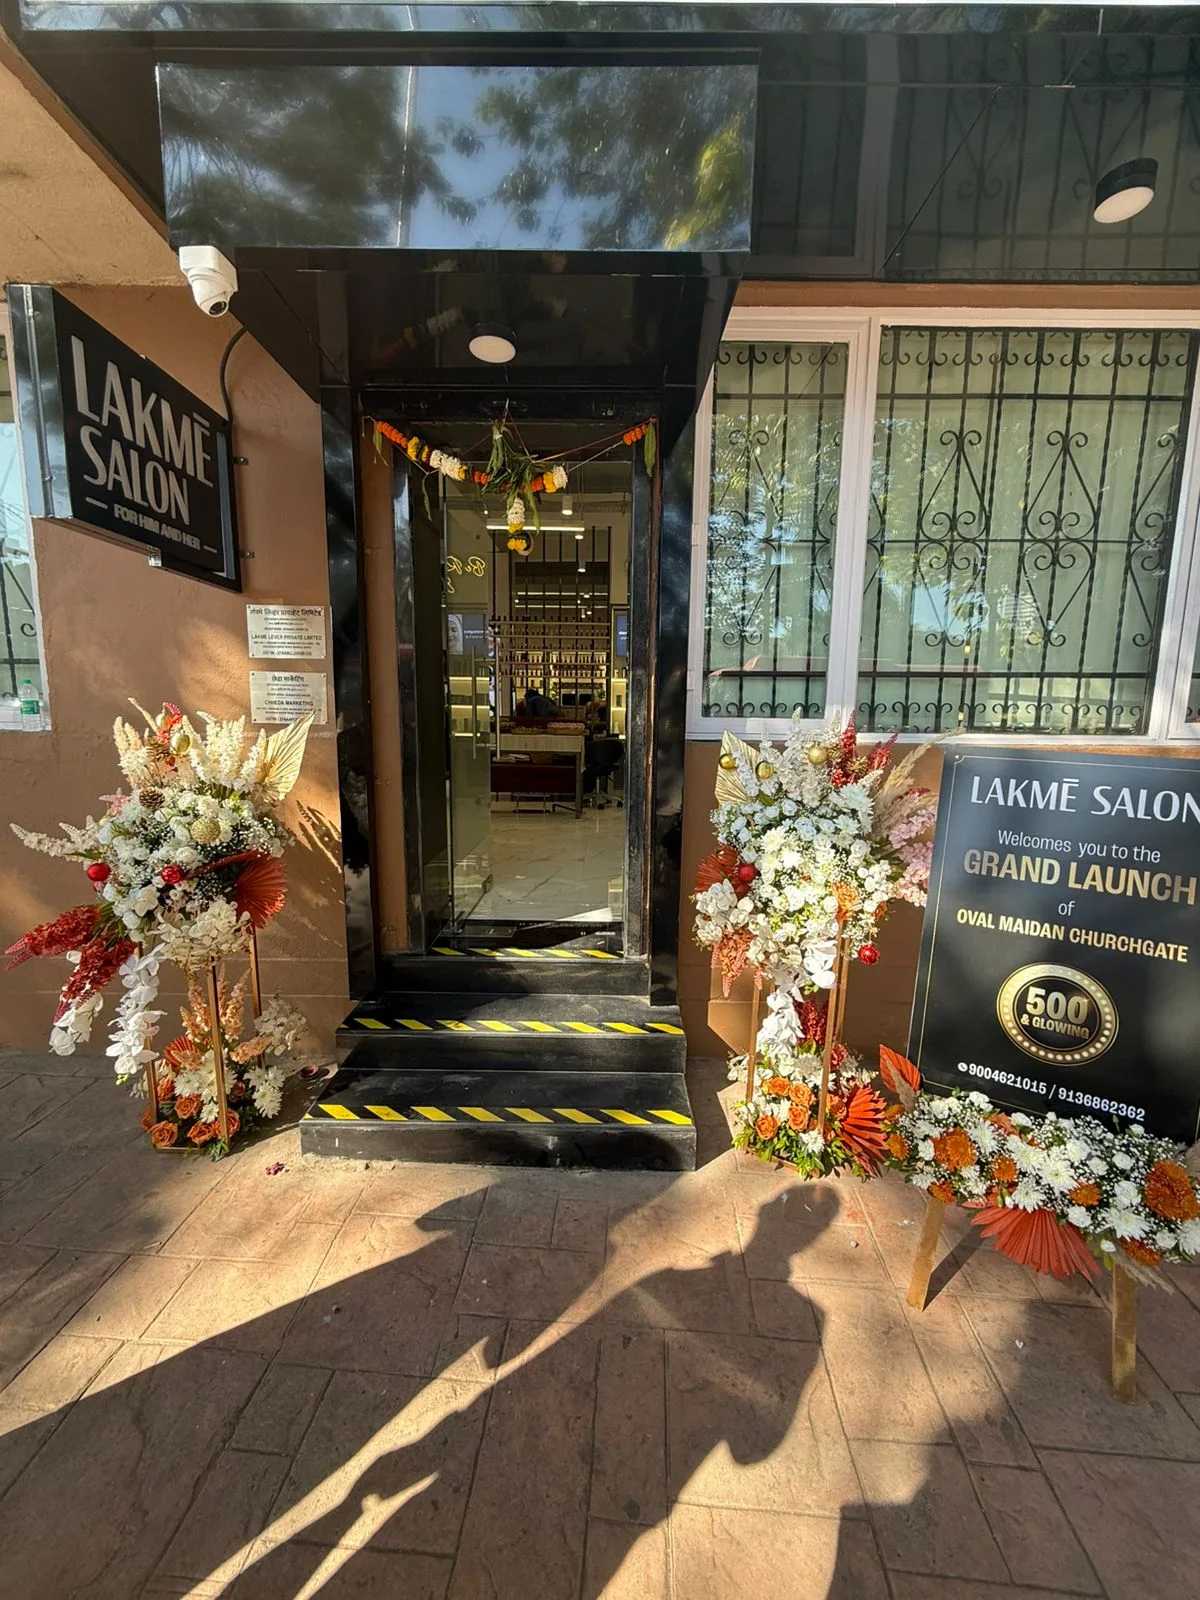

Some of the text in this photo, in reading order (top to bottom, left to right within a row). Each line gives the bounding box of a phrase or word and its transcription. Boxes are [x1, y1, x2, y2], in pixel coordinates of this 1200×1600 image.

[80, 425, 190, 525] SALON
[113, 503, 201, 551] FOR HIM AND HER
[998, 829, 1161, 864] Welcomes you to the
[963, 847, 1196, 905] GRAND LAUNCH
[1058, 900, 1076, 917] of
[956, 908, 1190, 963] OVAL MAIDAN CHURCHGATE
[1020, 1013, 1090, 1040] & GLOWING
[1025, 986, 1089, 1025] 500
[968, 1063, 1146, 1122] 9004621015 / 9136862362
